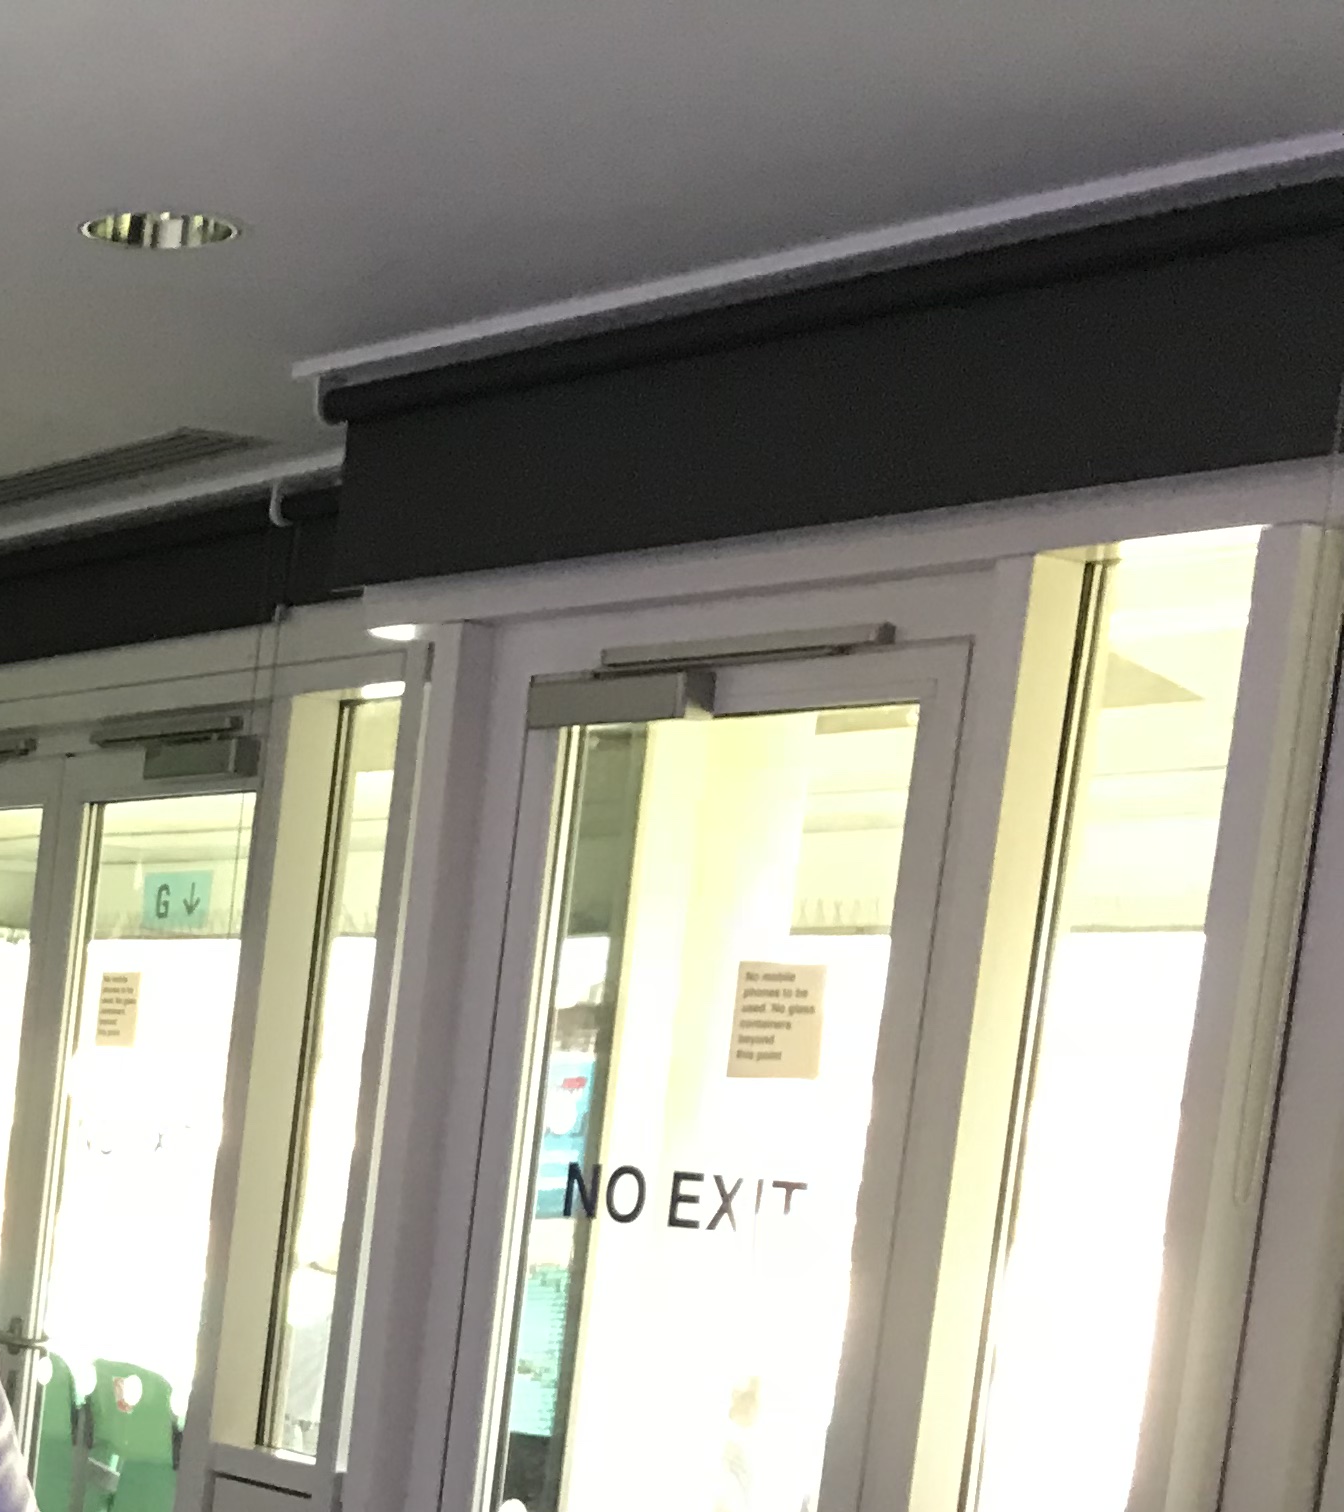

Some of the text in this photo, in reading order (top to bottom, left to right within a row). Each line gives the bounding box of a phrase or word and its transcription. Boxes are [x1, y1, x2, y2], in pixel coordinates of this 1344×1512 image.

[155, 883, 170, 919] G
[562, 1161, 808, 1232] NO EXIT
